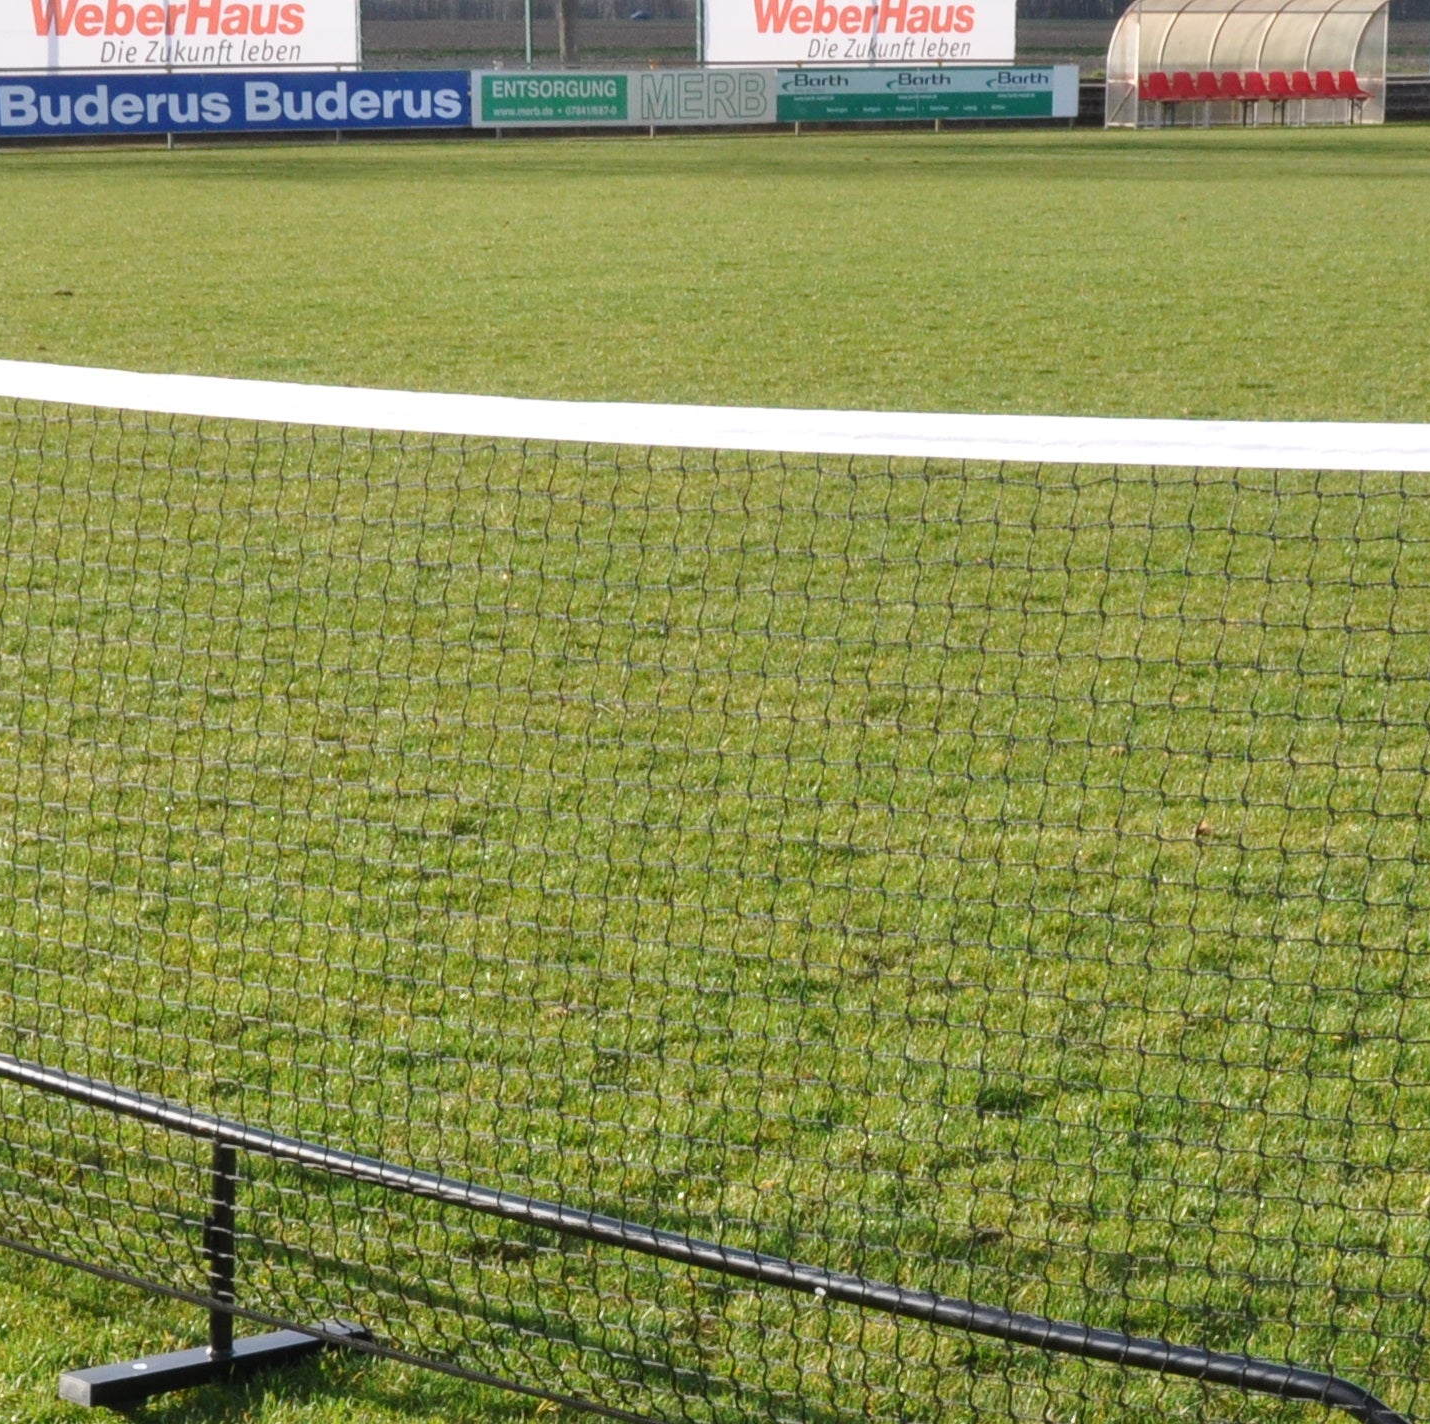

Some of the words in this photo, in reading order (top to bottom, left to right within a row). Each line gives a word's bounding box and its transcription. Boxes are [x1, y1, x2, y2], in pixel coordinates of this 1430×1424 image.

[32, 0, 305, 37] WeberHaus
[753, 0, 975, 34] WeberHaus
[100, 41, 137, 63] Die
[145, 39, 234, 65] Zukunft
[240, 40, 301, 62] leben
[807, 39, 839, 59] Die
[843, 37, 918, 60] Zukunft
[920, 37, 971, 57] leben
[492, 80, 617, 98] ENTSORGUNG
[794, 73, 849, 88] Barth
[898, 72, 951, 87] Barth
[997, 71, 1049, 85] Barth
[245, 80, 463, 122] Buderus
[641, 72, 768, 120] MERB
